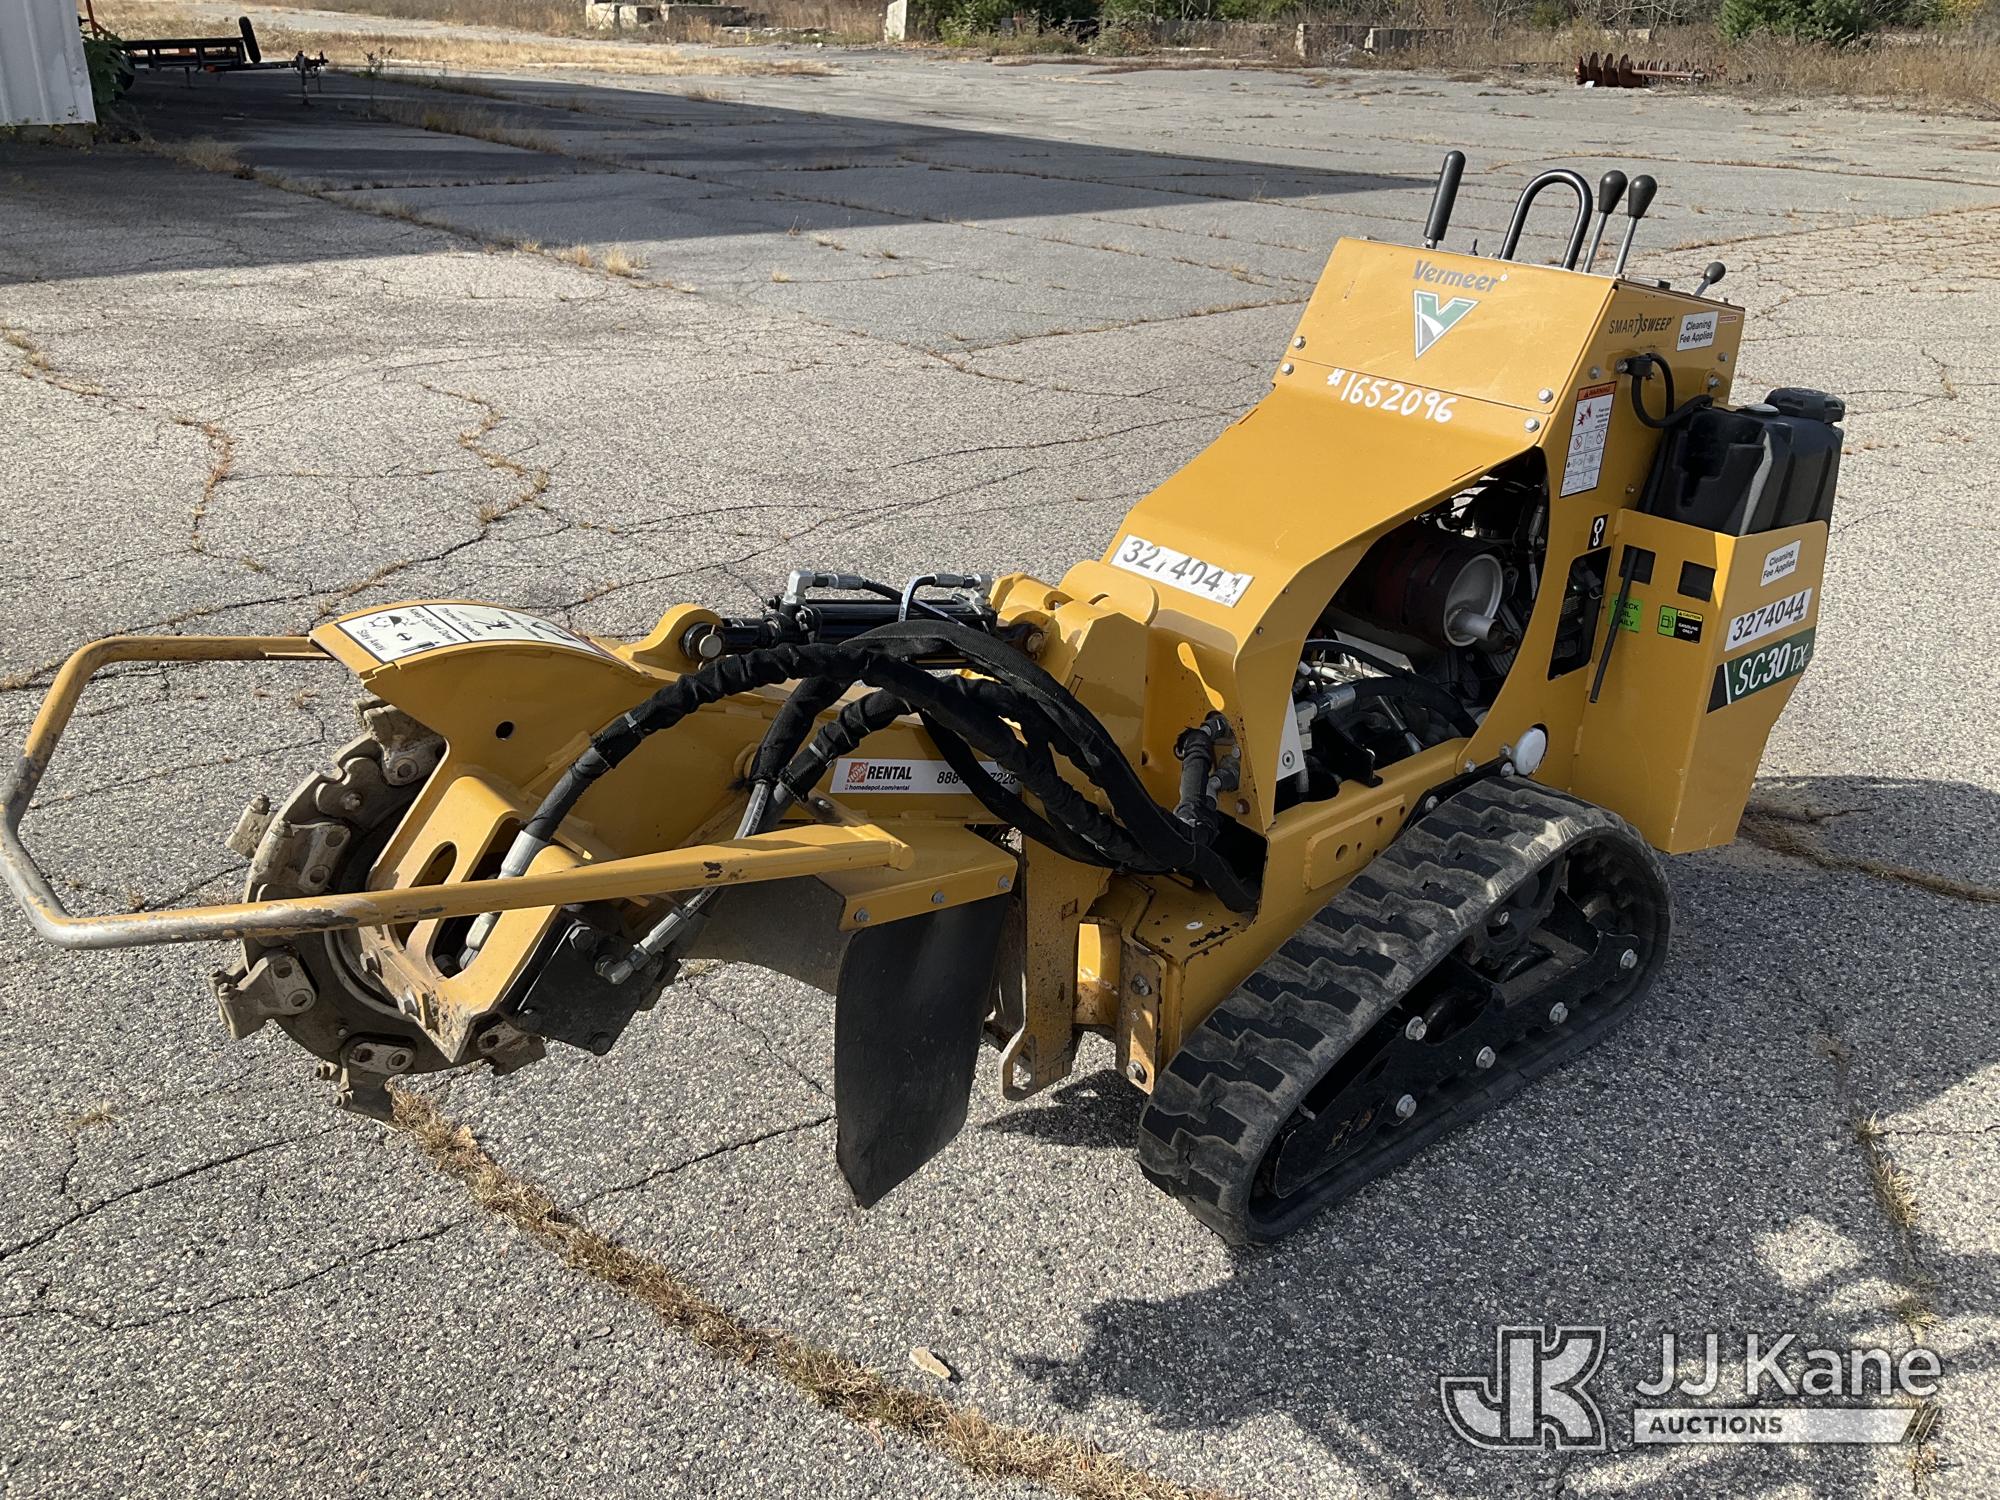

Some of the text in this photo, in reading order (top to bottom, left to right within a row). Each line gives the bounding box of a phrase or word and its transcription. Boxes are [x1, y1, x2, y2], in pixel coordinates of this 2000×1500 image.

[1413, 260, 1498, 293] Vermeer
[1685, 320, 1711, 331] Cleaning
[1680, 330, 1713, 343] Fee Applies
[1327, 368, 1458, 424] #1652096
[1769, 550, 1794, 566] Cleaning
[1763, 559, 1795, 579] Fee Applies
[1732, 592, 1806, 641] 3274044
[867, 766, 912, 780] RENTAL
